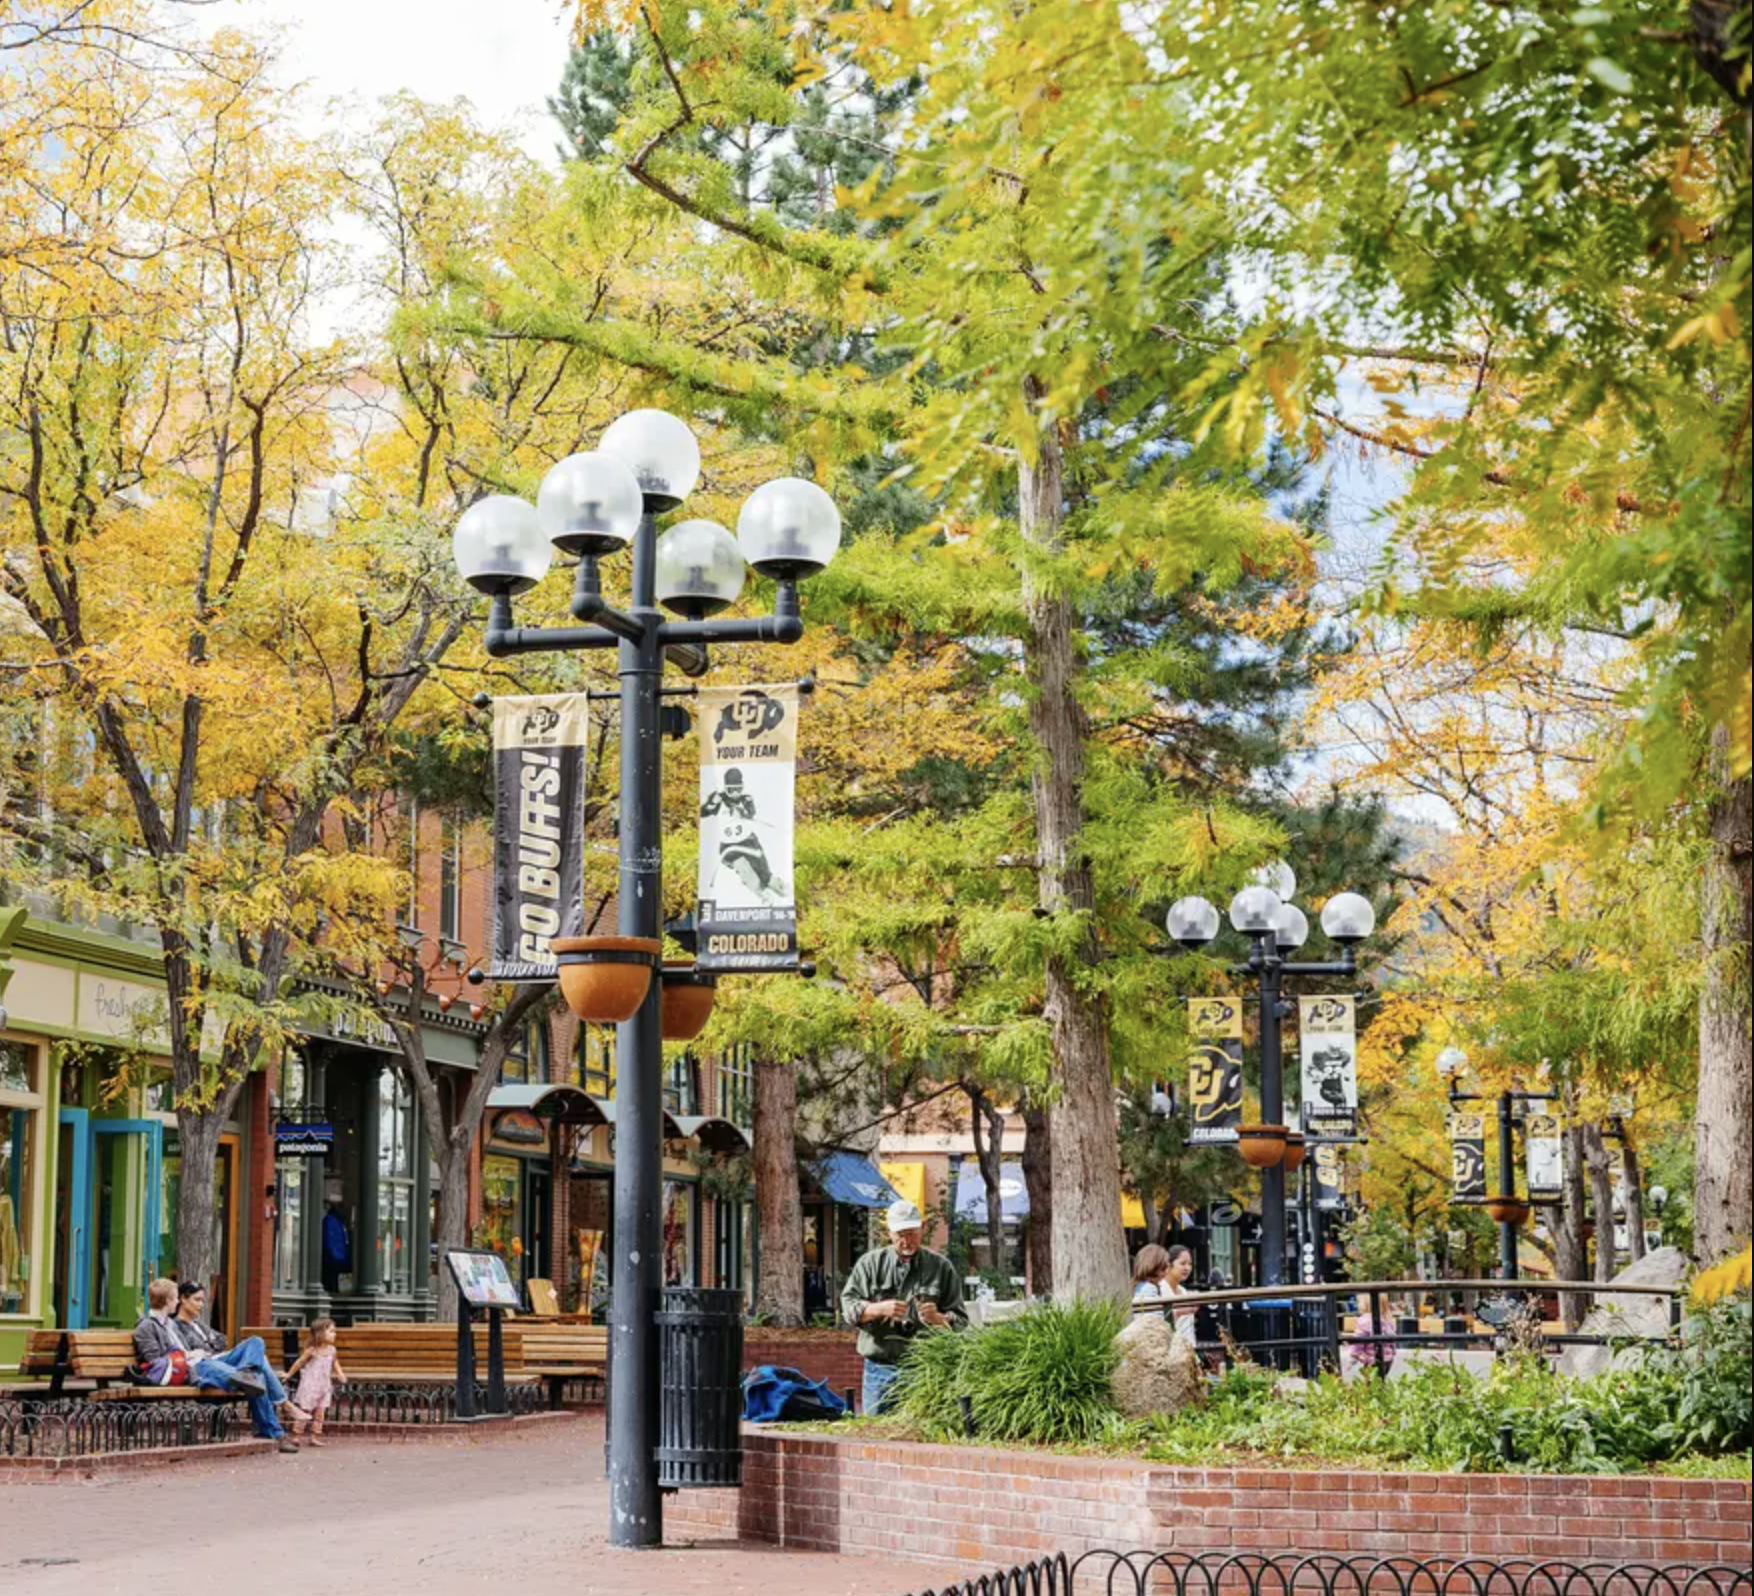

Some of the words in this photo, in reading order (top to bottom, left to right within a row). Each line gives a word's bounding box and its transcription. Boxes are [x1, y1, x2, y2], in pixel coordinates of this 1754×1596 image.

[716, 746, 745, 760] YOUR
[749, 744, 779, 758] TEAM
[519, 750, 561, 900] BUFFS!
[715, 907, 772, 922] DAVENPORT
[519, 902, 561, 966] GO
[707, 932, 789, 954] COLORADO
[279, 1143, 329, 1154] patagonia
